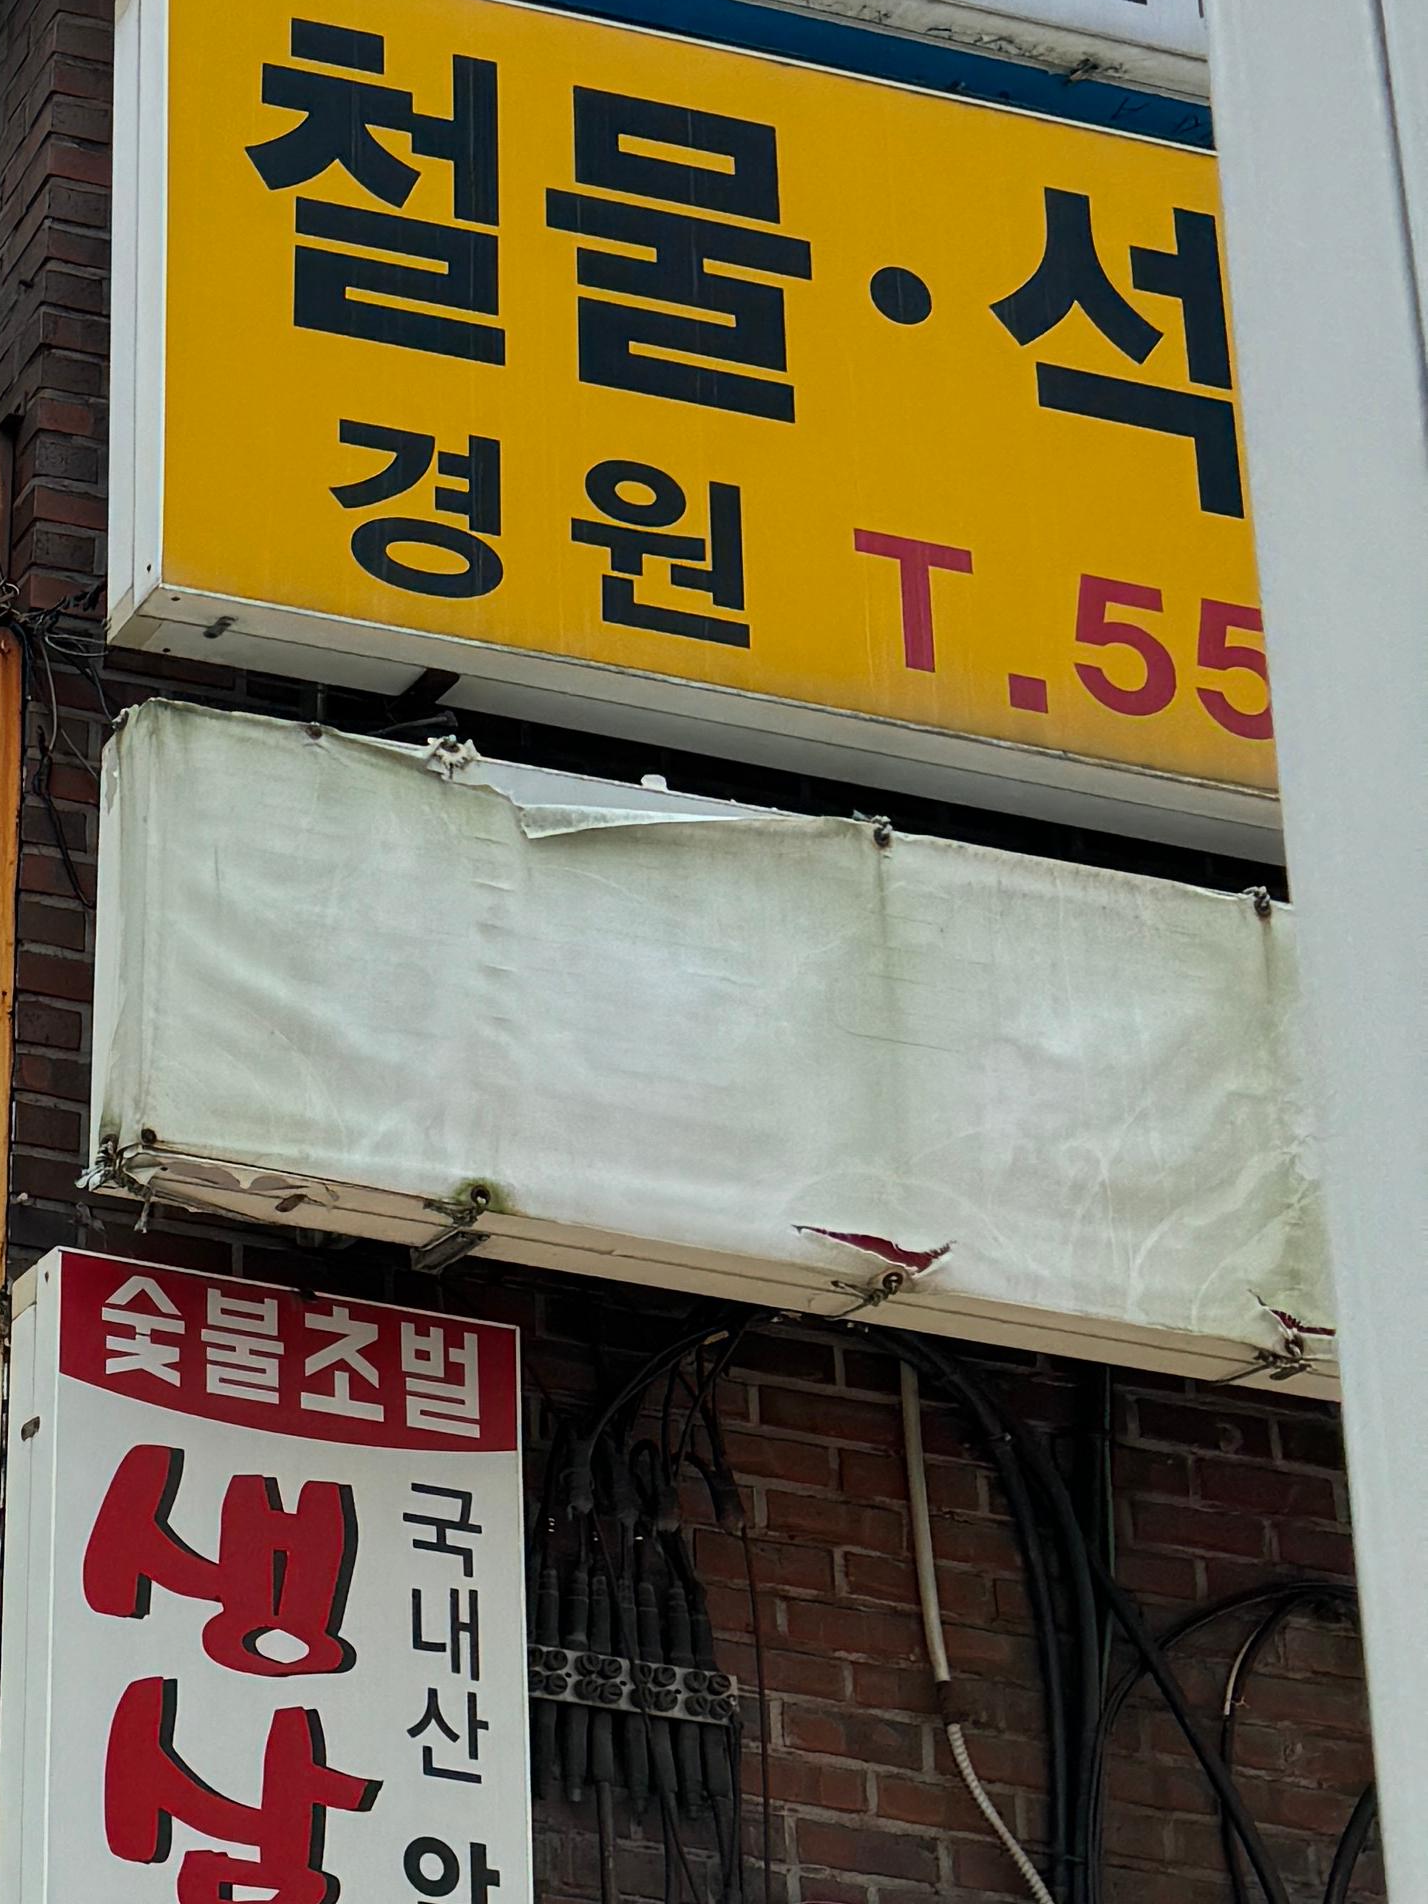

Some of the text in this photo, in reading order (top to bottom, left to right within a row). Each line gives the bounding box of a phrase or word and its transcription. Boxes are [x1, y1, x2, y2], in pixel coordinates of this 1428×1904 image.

[329, 418, 750, 649] 경원
[102, 1274, 481, 1438] 숯불초벌
[402, 1482, 489, 1785] 국내산
